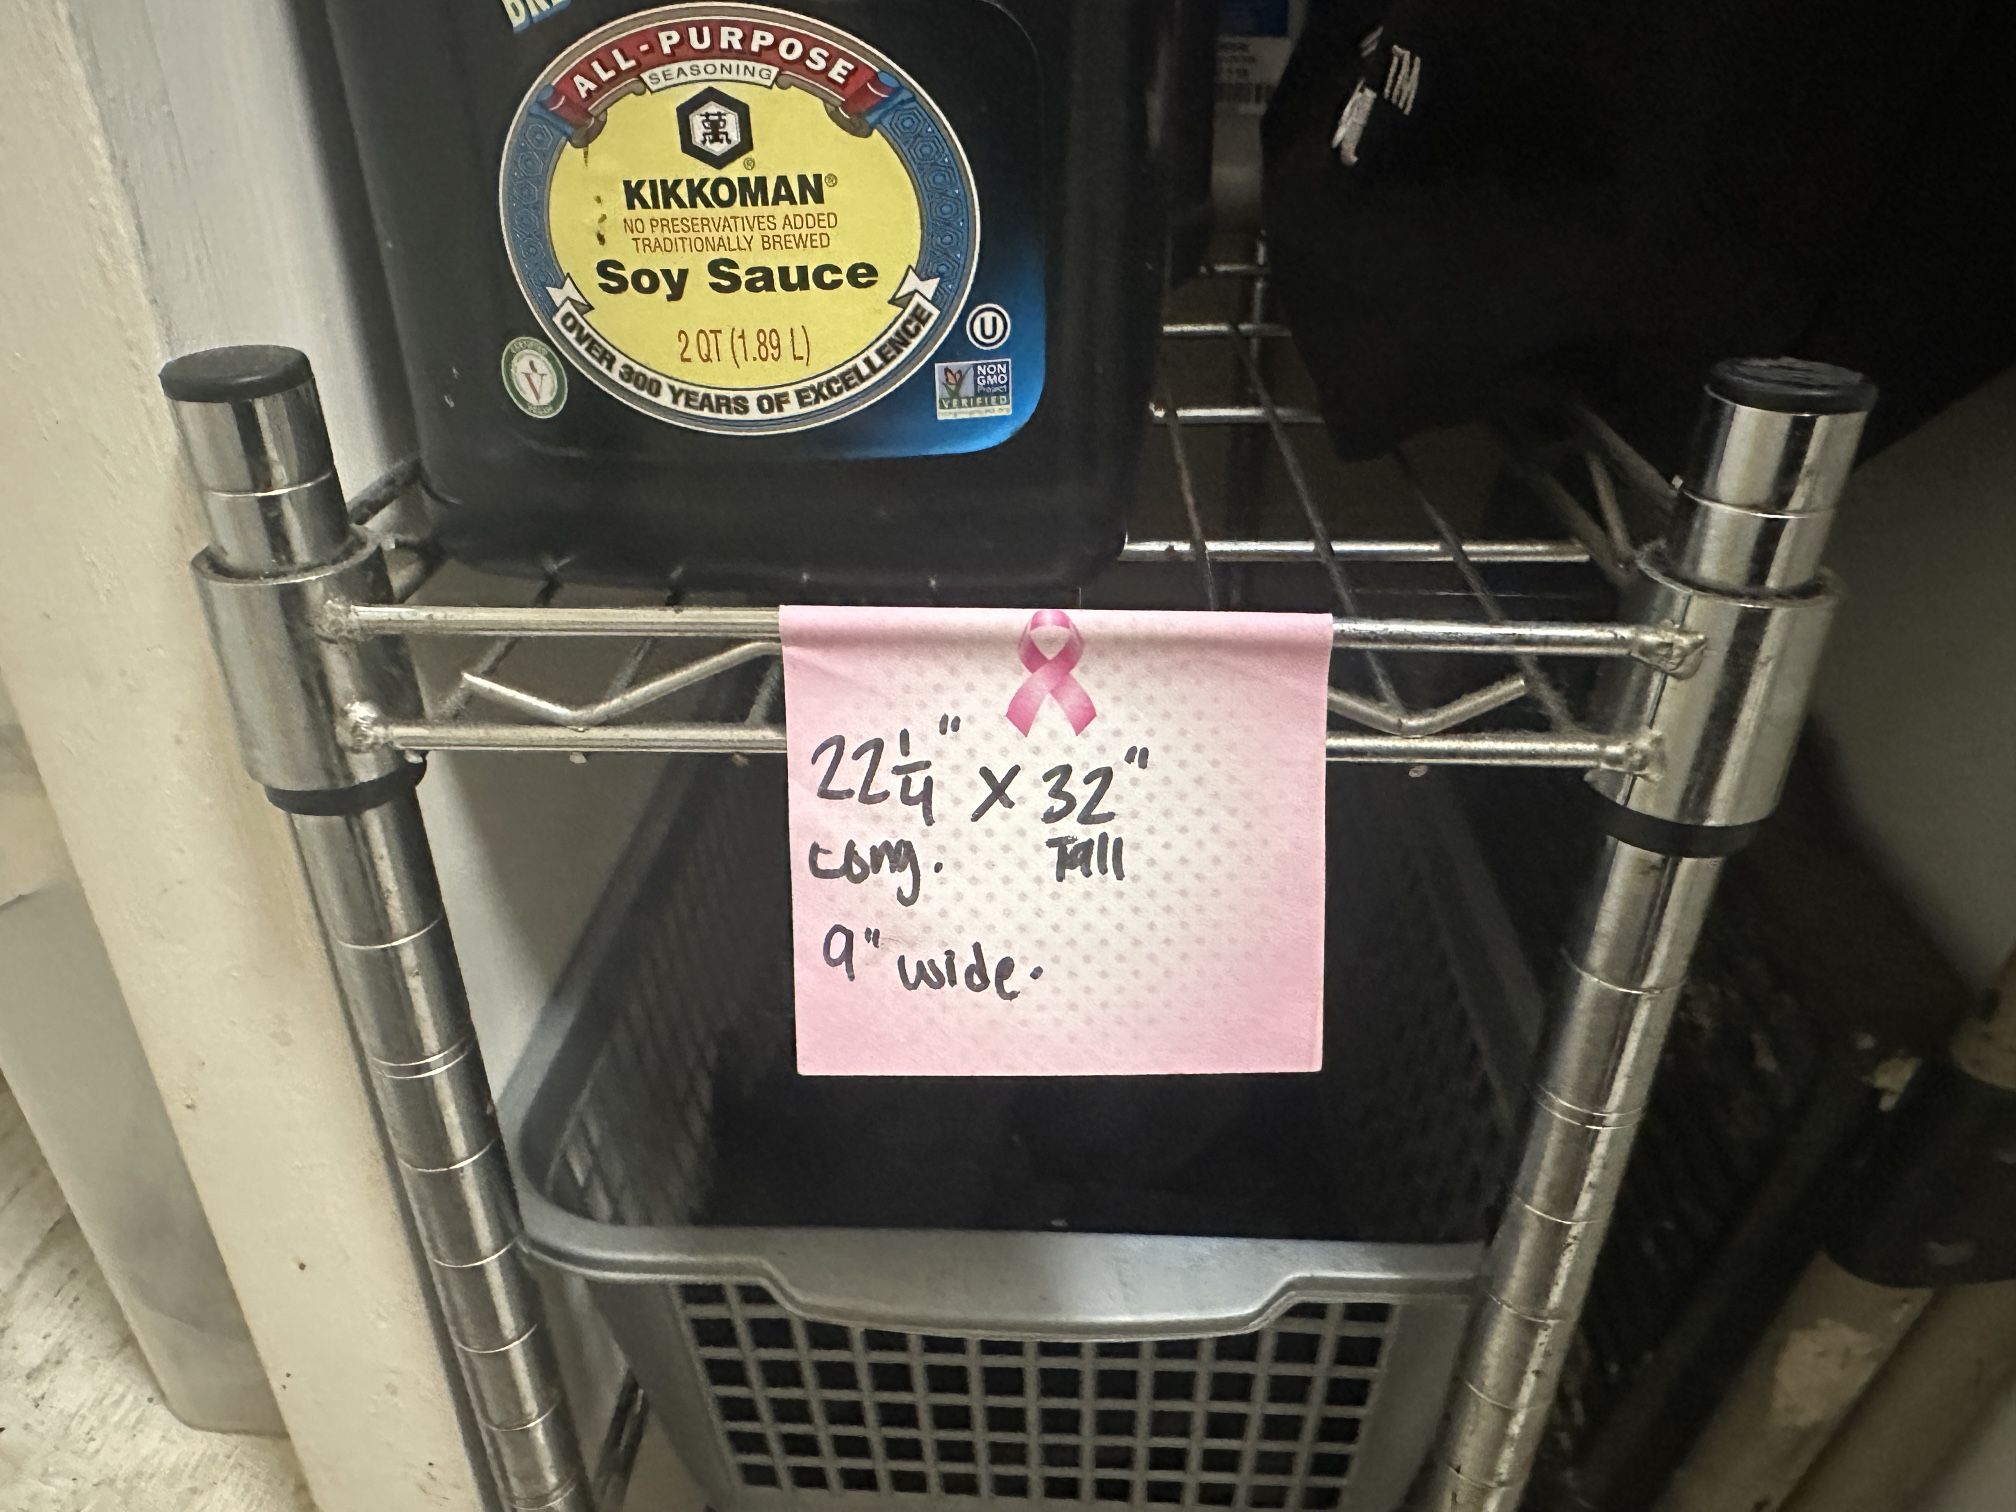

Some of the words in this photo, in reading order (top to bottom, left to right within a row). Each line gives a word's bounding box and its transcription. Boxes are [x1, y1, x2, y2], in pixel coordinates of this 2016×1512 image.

[572, 26, 855, 99] ALL-PURPOSE
[649, 63, 773, 85] SEASONING
[623, 218, 645, 234] NO
[649, 214, 777, 234] PRESERVATIVES
[782, 212, 838, 230] ADDED
[632, 235, 753, 254] TRADITIONALLY
[761, 232, 830, 251] BREWED
[596, 259, 689, 302] Soy
[707, 257, 879, 294] Sauce
[677, 329, 692, 363] 2
[696, 328, 722, 363] QT
[730, 326, 781, 369] (1.89
[790, 325, 810, 367] L)
[560, 311, 617, 373] OVER
[618, 363, 662, 399] 300
[667, 383, 750, 416] YEARS
[756, 391, 791, 415] OF
[794, 301, 934, 410] EXCELLENCE
[977, 363, 1007, 375] NON
[976, 373, 1008, 386] GMO
[941, 395, 1007, 409] VERIFIED
[1041, 745, 1149, 826] 32"
